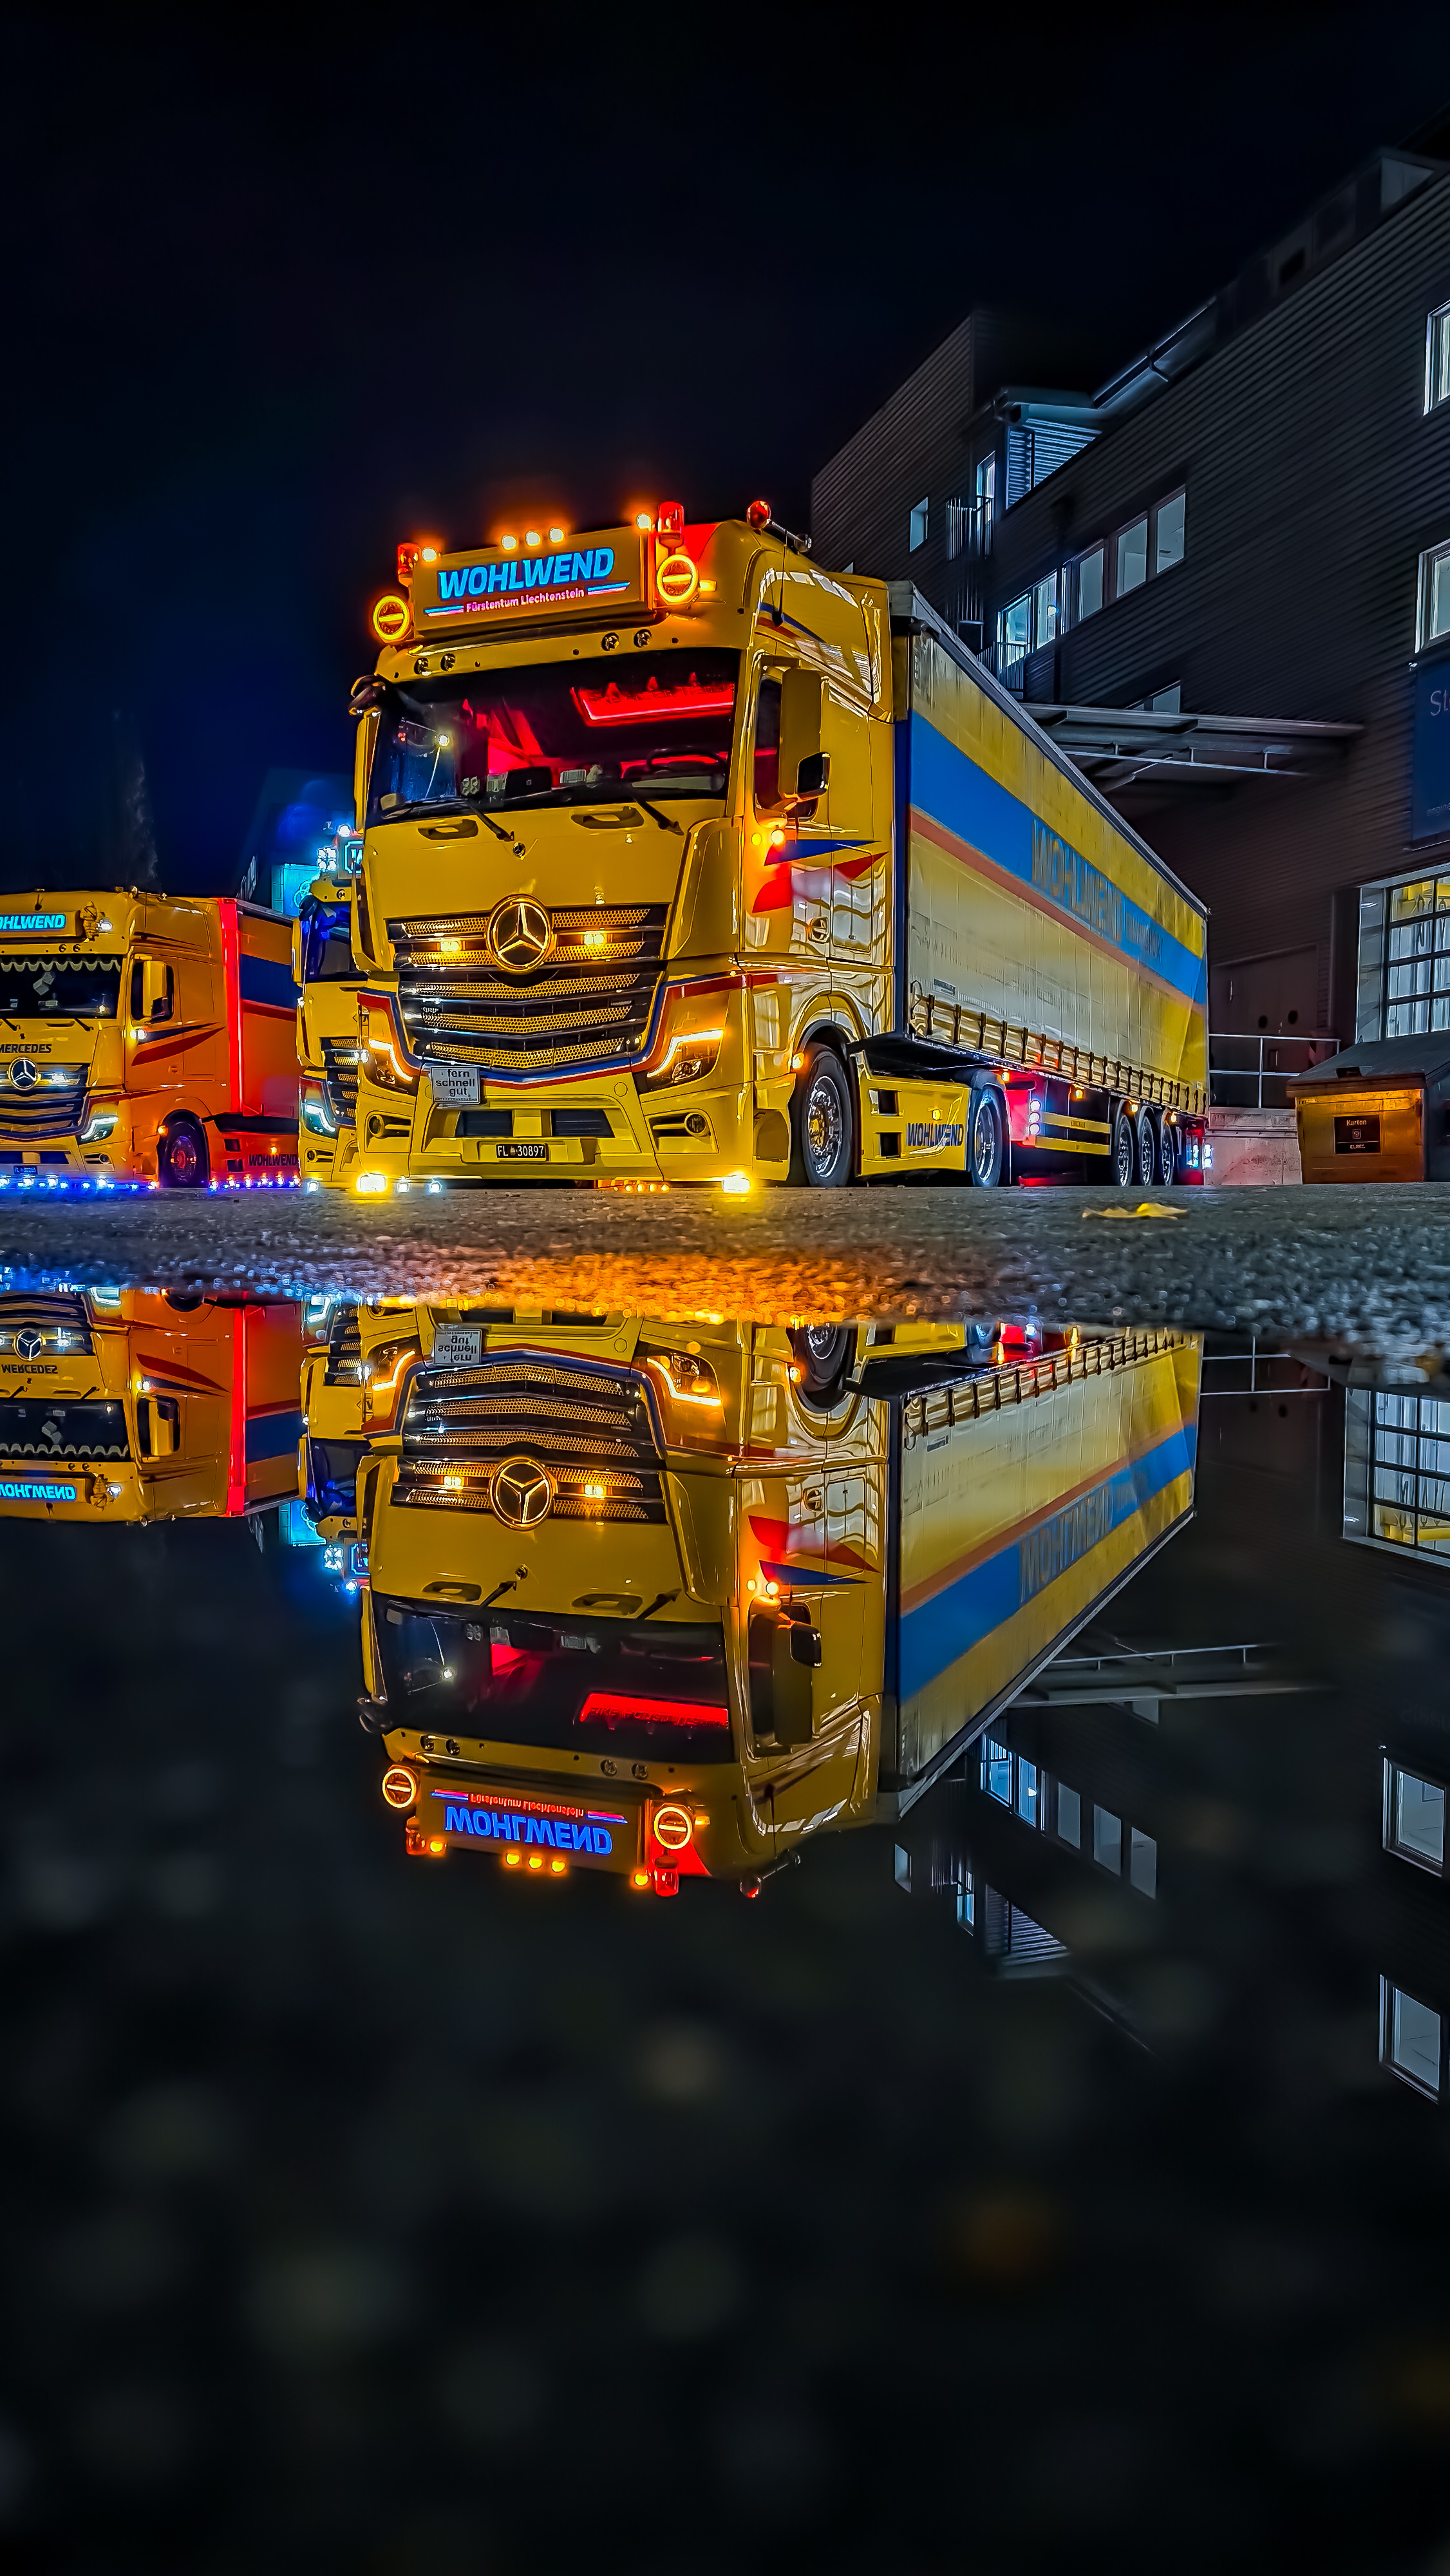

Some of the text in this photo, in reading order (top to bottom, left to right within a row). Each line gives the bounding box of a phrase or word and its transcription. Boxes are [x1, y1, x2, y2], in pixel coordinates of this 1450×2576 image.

[438, 548, 614, 599] WOHLWEND
[466, 588, 584, 612] Fürstentum Liechtenstein
[1430, 689, 1450, 716] St
[1031, 817, 1122, 942] WOHLWEND
[449, 1087, 467, 1097] gut
[906, 1123, 964, 1146] WOHLWEND
[249, 1154, 298, 1166] WOHLWEND
[498, 1145, 544, 1157] FL 30897
